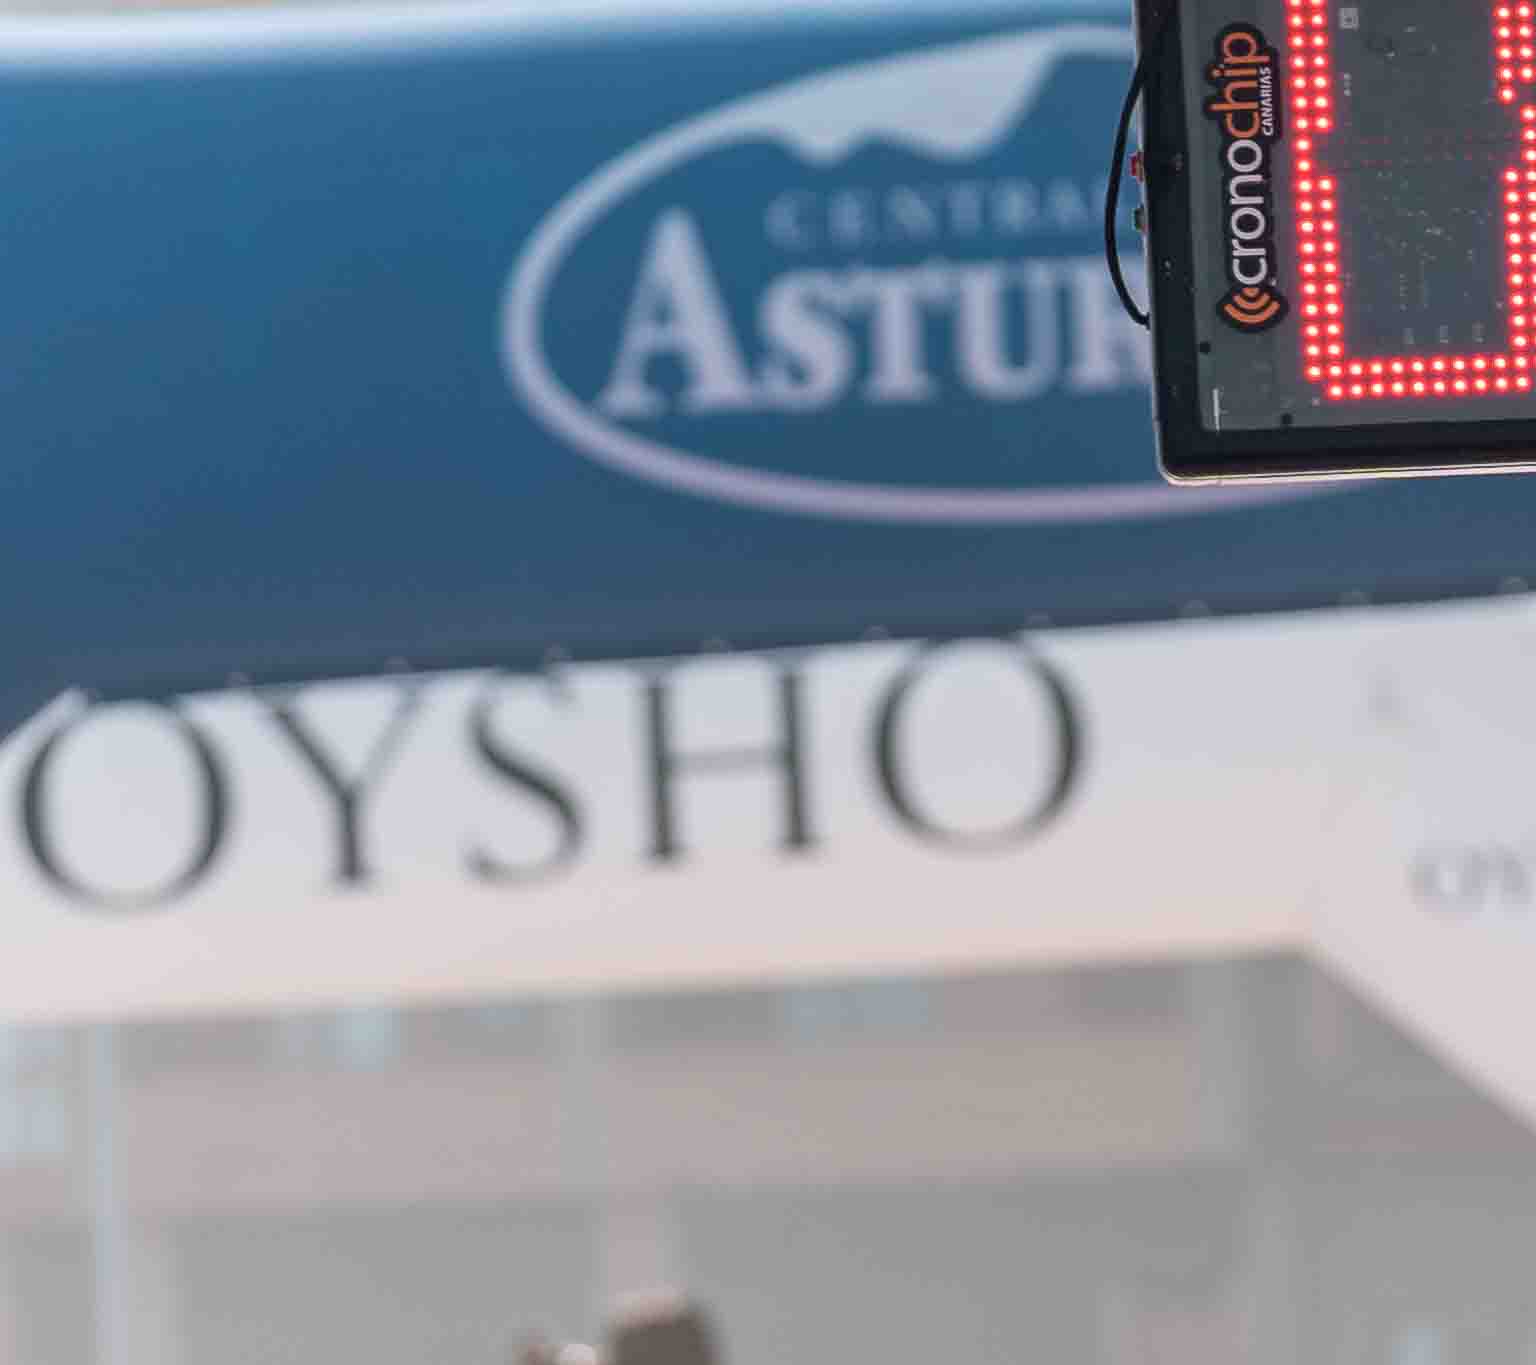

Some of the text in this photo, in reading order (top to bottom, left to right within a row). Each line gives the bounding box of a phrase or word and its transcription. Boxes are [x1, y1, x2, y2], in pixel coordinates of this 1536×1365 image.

[1209, 31, 1270, 286] cronochip
[1260, 67, 1274, 136] CANARIAS
[598, 206, 1150, 418] ASTUR
[18, 636, 1088, 914] OYSHO
